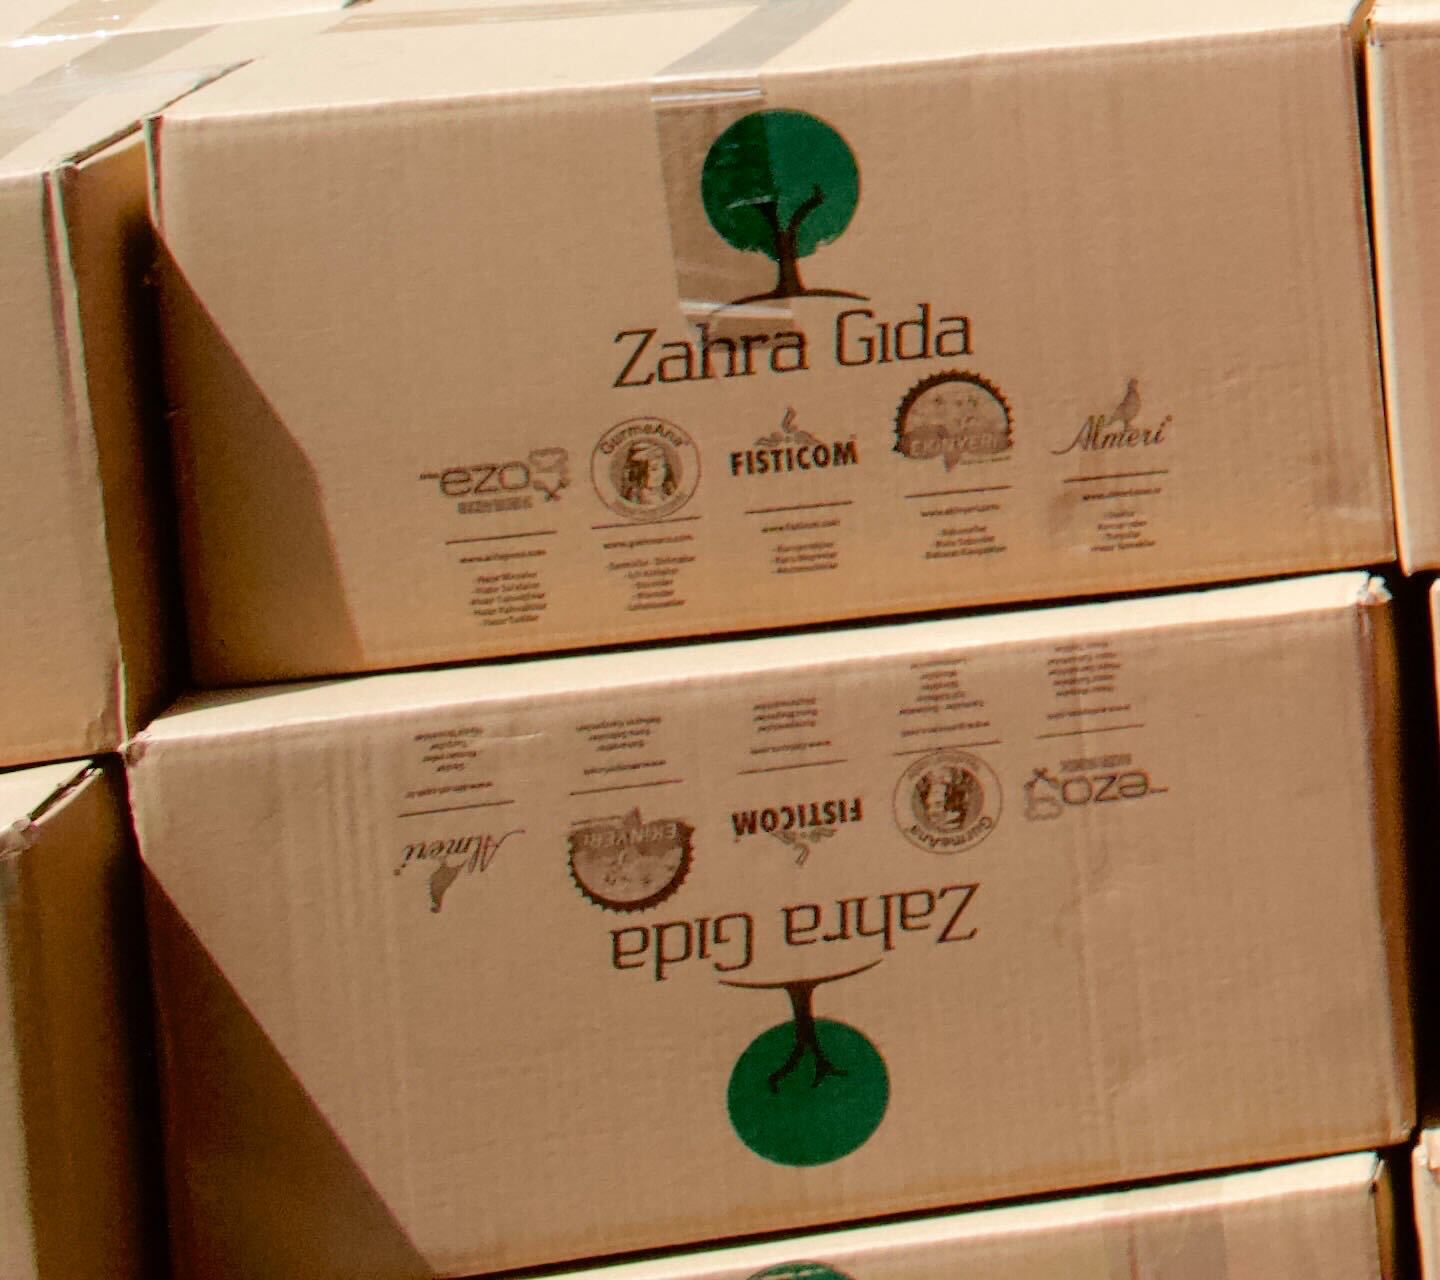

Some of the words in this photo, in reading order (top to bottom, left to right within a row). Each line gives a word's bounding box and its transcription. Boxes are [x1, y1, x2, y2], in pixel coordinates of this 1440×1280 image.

[612, 322, 810, 389] Zahra
[836, 302, 975, 368] Gıda
[440, 460, 530, 497] ezo
[730, 440, 859, 476] FISTICOM
[1061, 768, 1150, 806] ezo
[731, 795, 864, 836] FISTICOM
[780, 882, 980, 952] Zahra
[610, 912, 754, 981] Gıda
